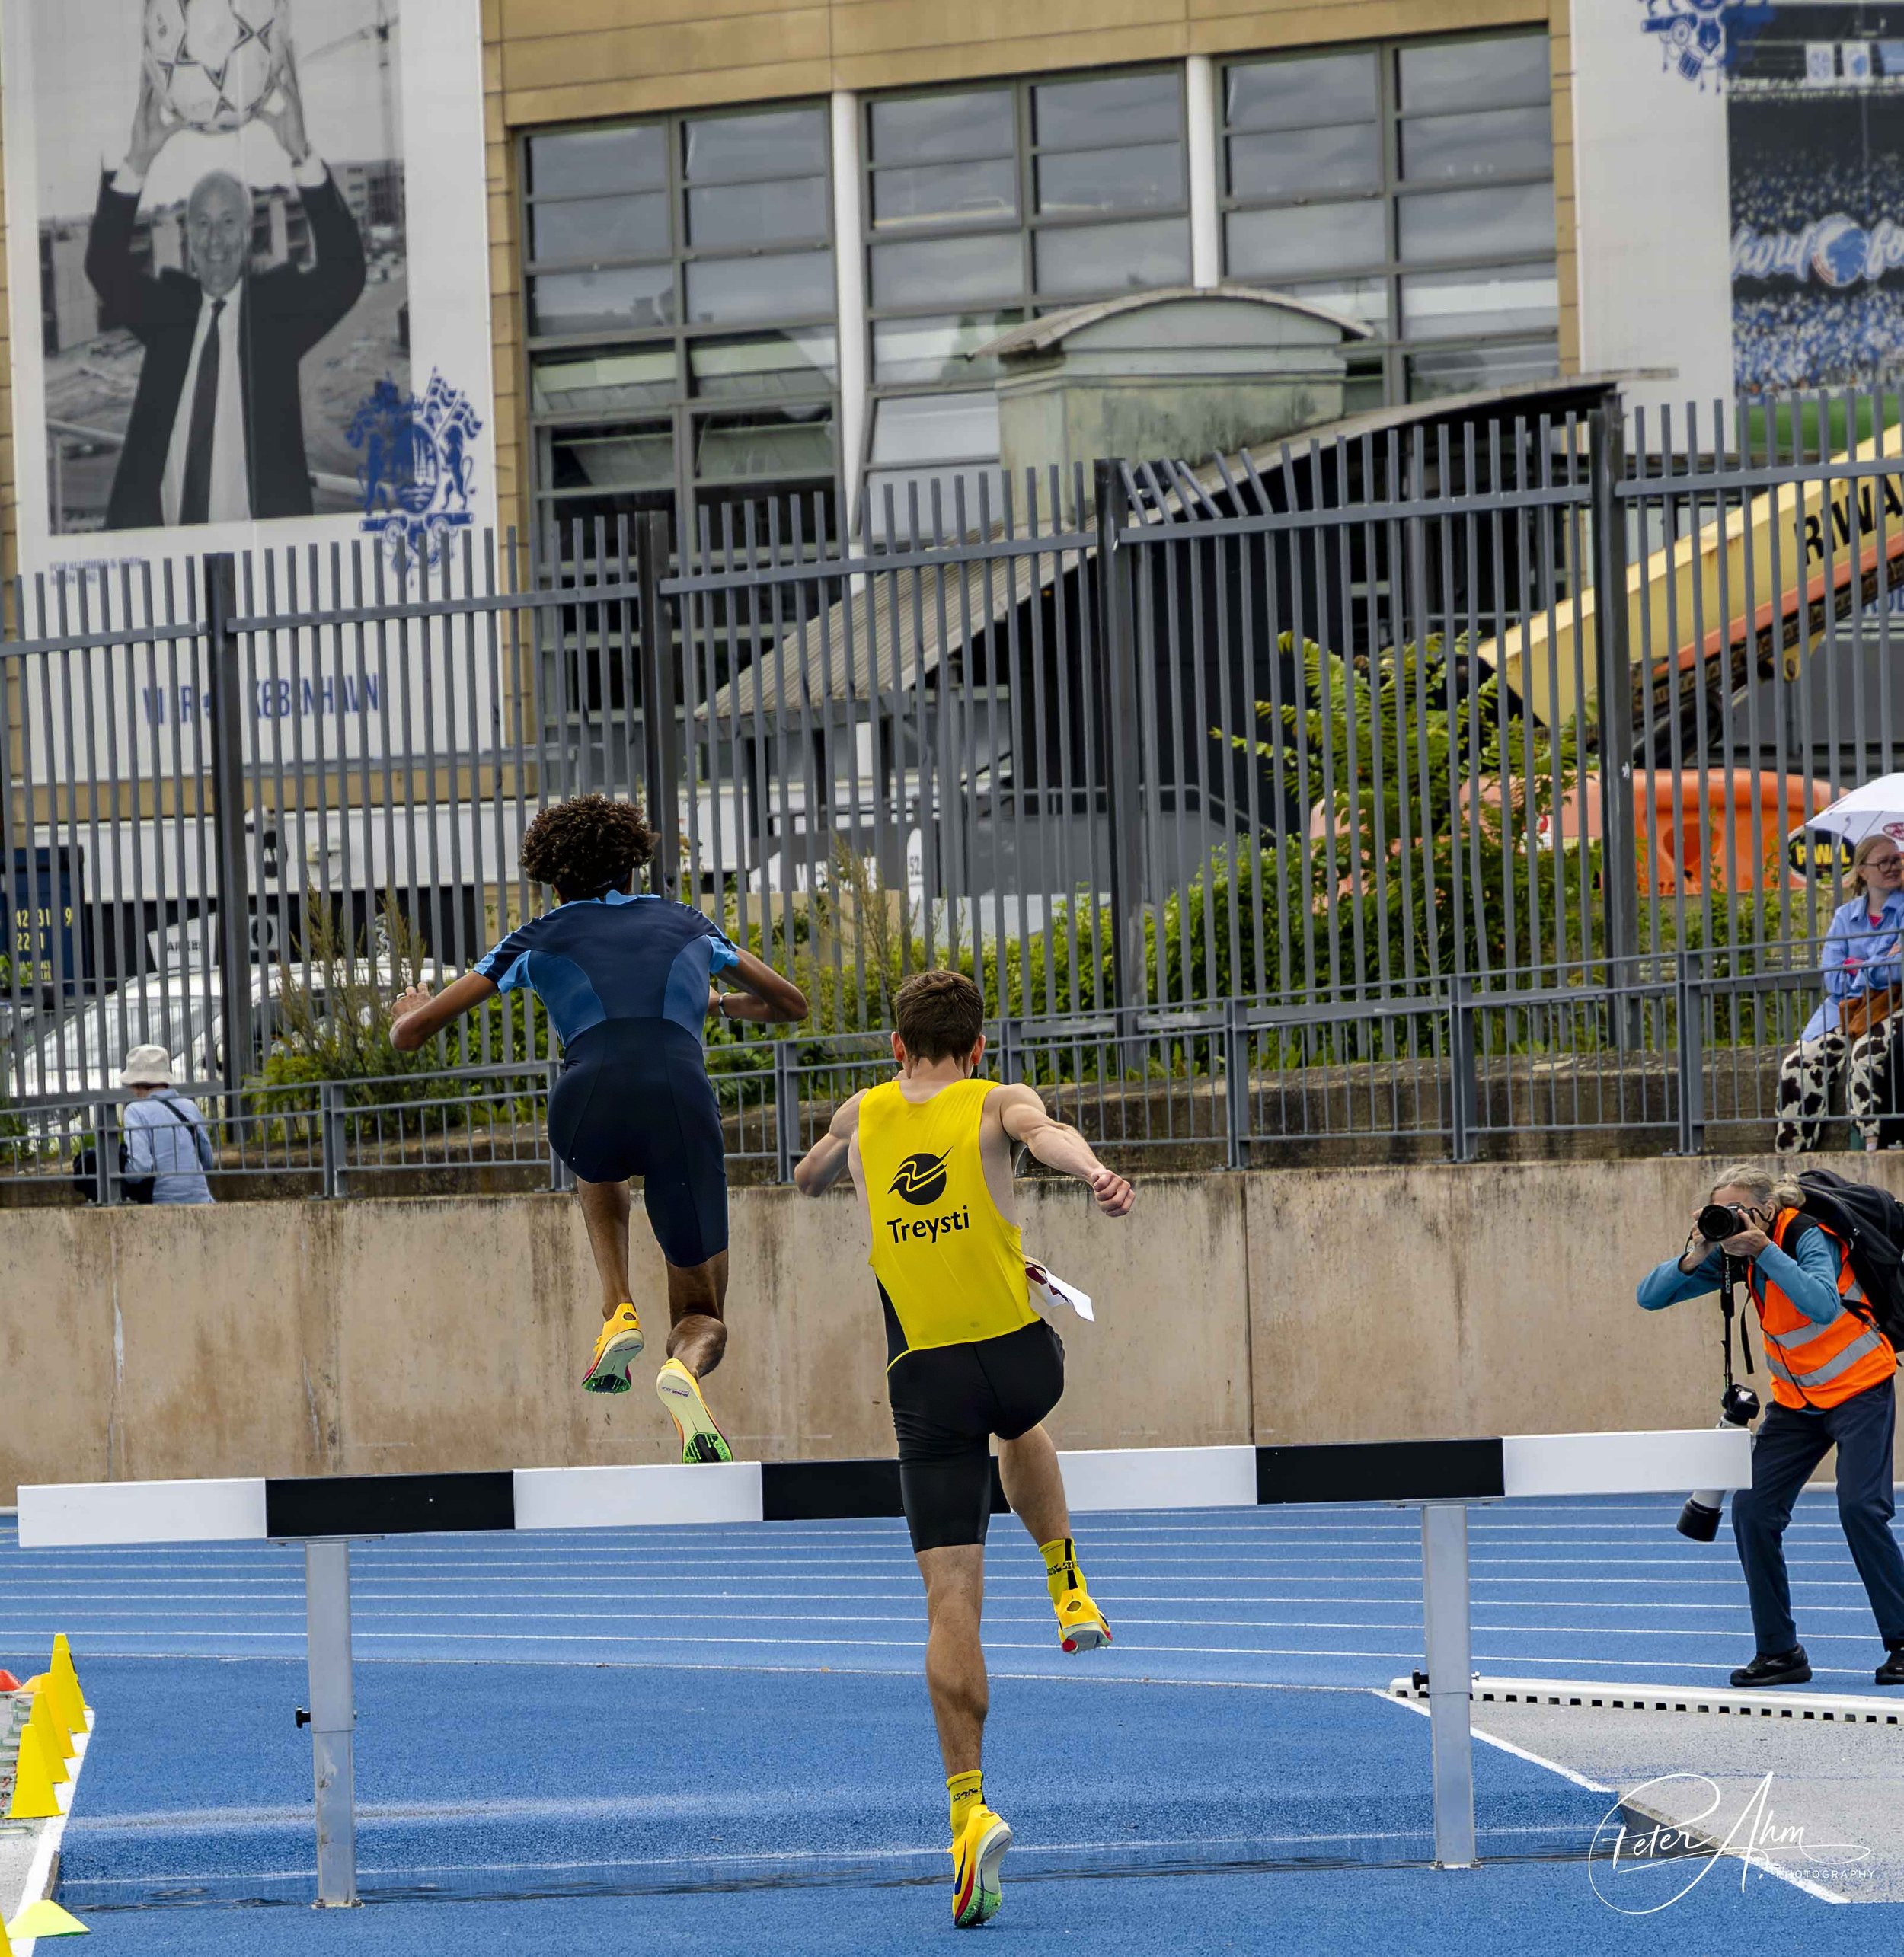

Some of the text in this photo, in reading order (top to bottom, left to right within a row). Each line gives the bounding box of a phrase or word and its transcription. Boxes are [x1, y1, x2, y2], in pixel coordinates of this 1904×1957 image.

[1794, 474, 1903, 565] RWA
[1795, 843, 1851, 867] RWL
[17, 932, 45, 951] 221
[887, 1205, 970, 1243] Treysti
